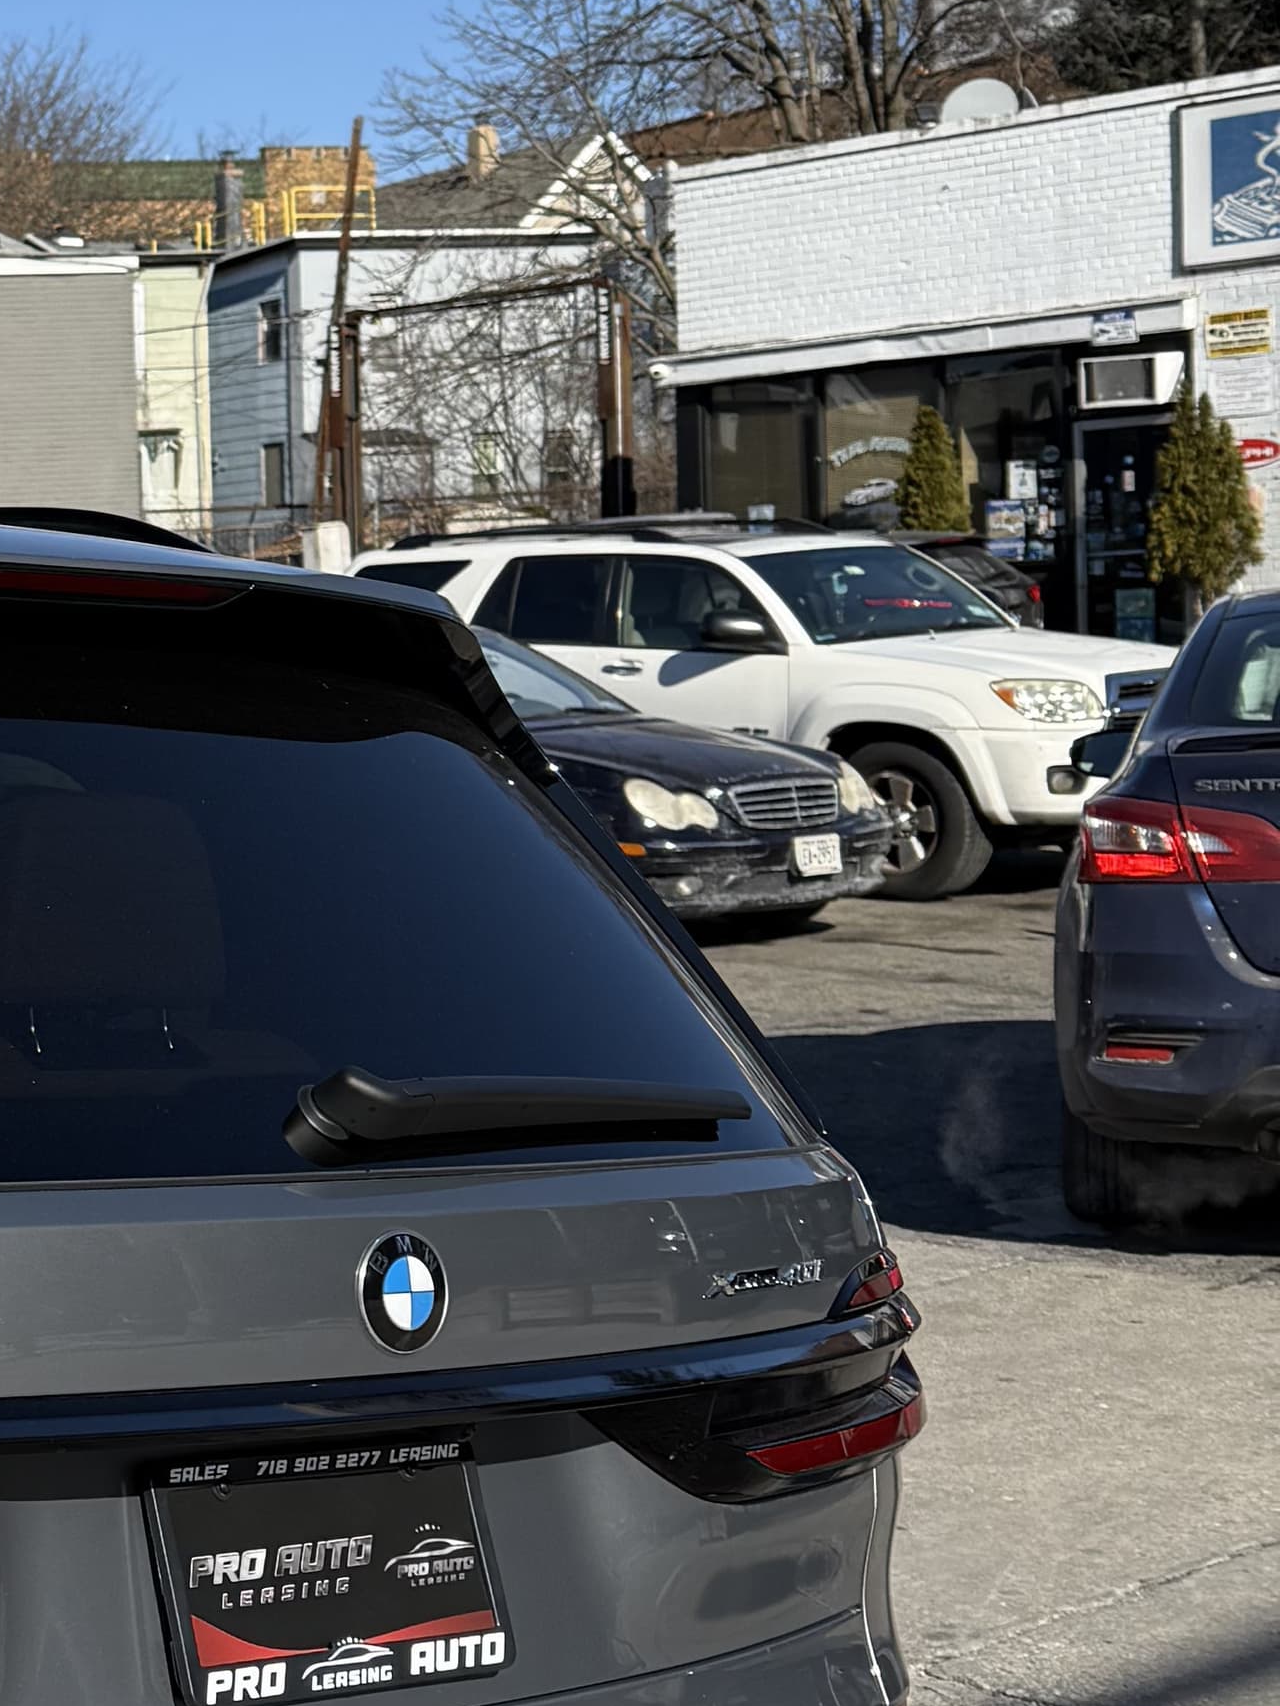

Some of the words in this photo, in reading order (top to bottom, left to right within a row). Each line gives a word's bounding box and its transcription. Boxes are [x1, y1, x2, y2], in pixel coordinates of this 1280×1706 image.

[368, 1234, 438, 1276] BMW
[169, 1464, 230, 1484] SALES
[256, 1460, 288, 1477] 718
[293, 1456, 330, 1473] 902
[335, 1451, 381, 1468] 2277
[388, 1443, 460, 1464] LEASING
[189, 1548, 267, 1589] PRO
[274, 1534, 374, 1578] AUTO
[397, 1562, 430, 1579] PRO
[432, 1555, 475, 1574] AUTO
[220, 1576, 351, 1610] LEASING
[205, 1662, 287, 1706] PRO
[311, 1664, 393, 1692] LEASING
[409, 1631, 506, 1676] AUTO
